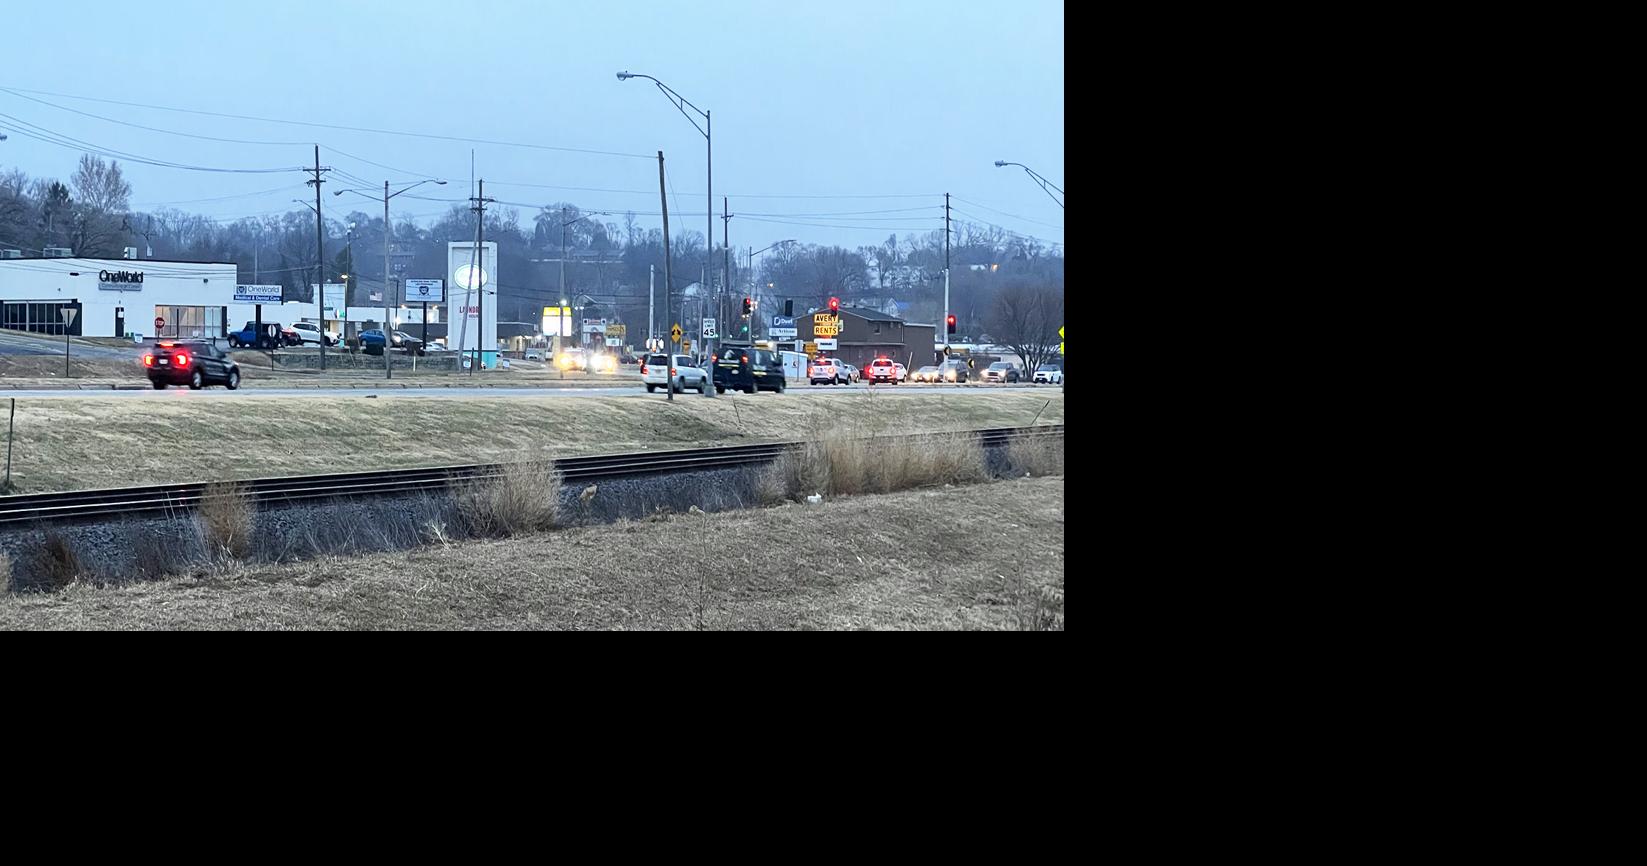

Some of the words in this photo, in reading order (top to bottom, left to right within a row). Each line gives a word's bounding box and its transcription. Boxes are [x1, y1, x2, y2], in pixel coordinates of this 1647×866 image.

[99, 269, 143, 283] OneWorld
[247, 285, 280, 293] OneWorld
[703, 328, 715, 337] 45
